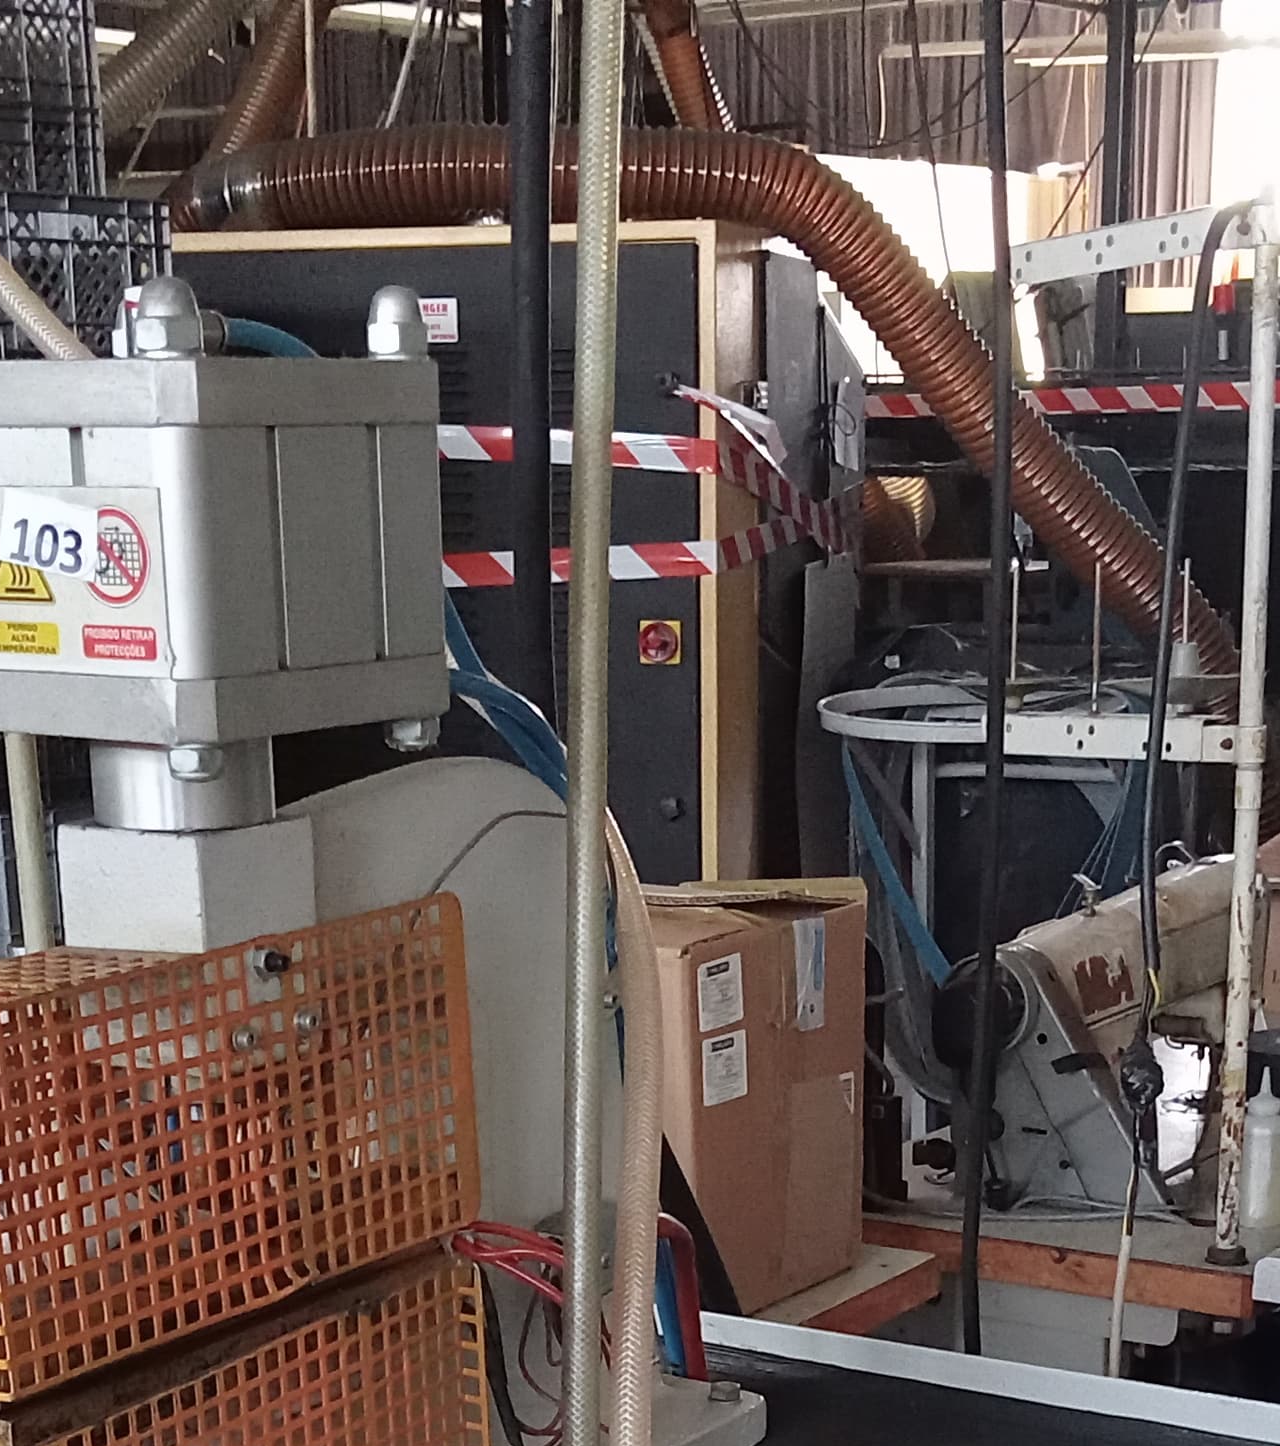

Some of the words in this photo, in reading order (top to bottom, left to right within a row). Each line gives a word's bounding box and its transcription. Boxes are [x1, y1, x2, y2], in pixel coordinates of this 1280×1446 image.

[422, 303, 448, 313] NGER
[9, 518, 83, 574] 103
[6, 623, 38, 633] PERIGO
[11, 633, 37, 643] ALTAS
[84, 627, 120, 640] PROIBIDO
[121, 629, 155, 641] RETIRAR
